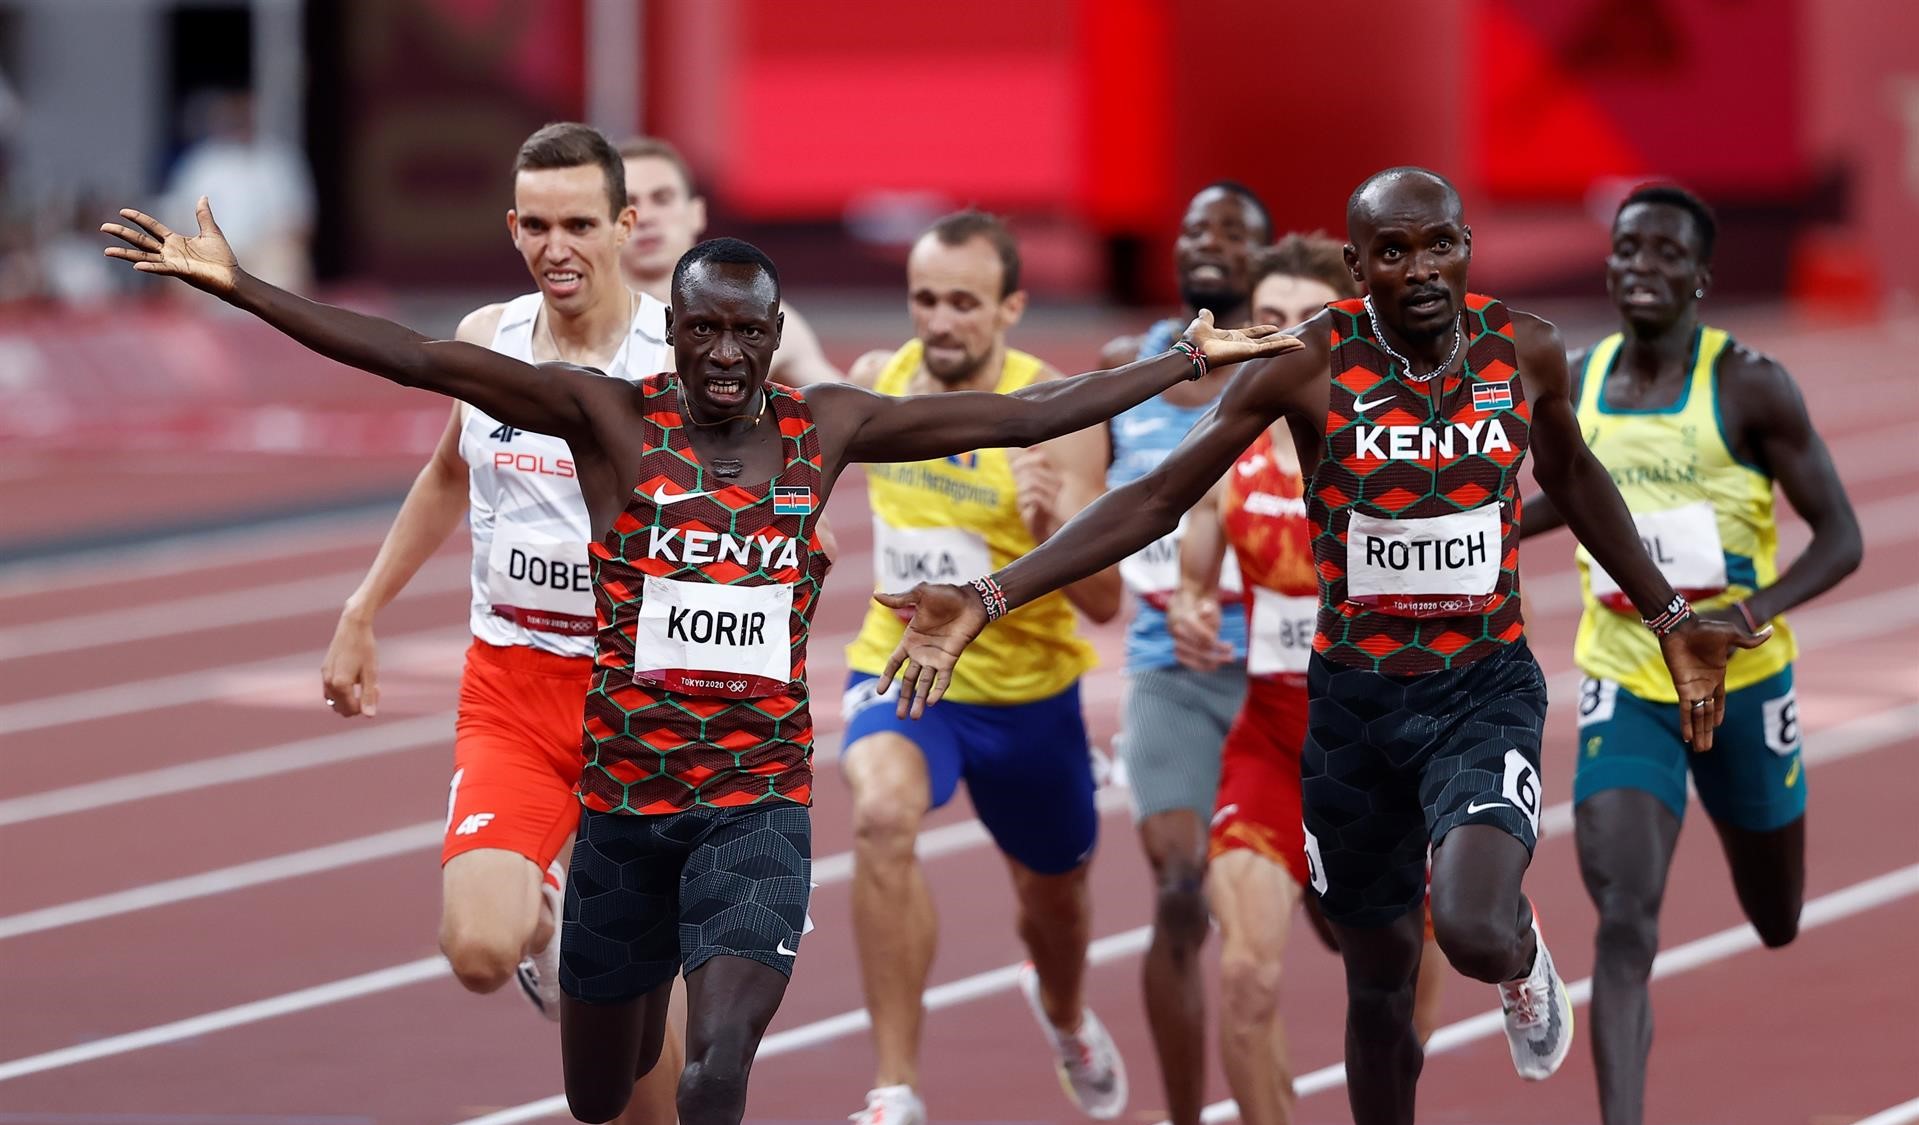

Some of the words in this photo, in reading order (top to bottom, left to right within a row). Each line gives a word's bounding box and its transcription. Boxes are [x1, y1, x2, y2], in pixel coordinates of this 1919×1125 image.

[1355, 419, 1512, 460] KENYA
[494, 452, 575, 478] POLS
[648, 526, 799, 570] KENYA
[1366, 531, 1486, 571] ROTICH
[509, 548, 591, 592] DOBE
[667, 606, 766, 646] KORIR
[1419, 602, 1437, 610] 2020
[681, 676, 704, 688] TOKYO
[705, 680, 725, 689] 2020
[1516, 766, 1536, 816] 6
[455, 812, 496, 836] 4F
